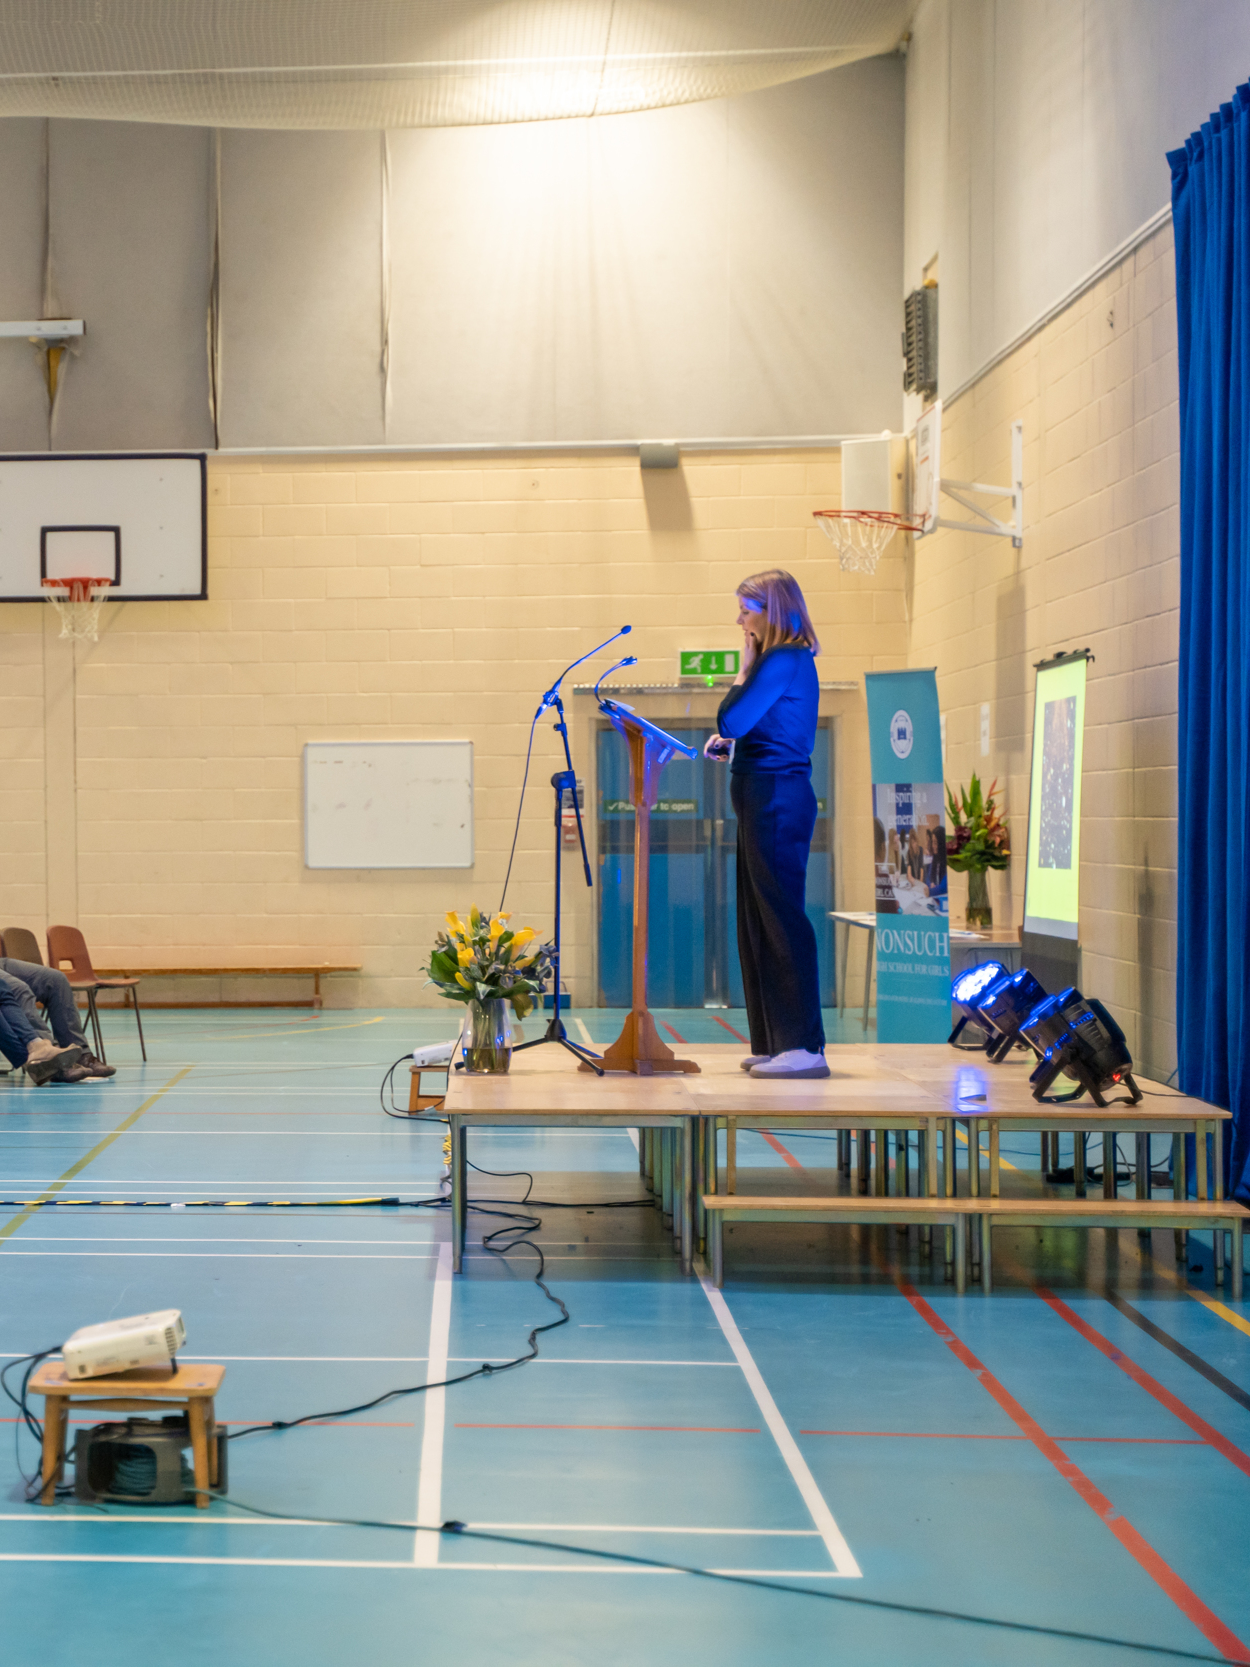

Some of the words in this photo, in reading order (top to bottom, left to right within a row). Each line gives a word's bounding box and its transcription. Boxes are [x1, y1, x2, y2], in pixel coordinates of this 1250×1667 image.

[660, 802, 669, 811] to
[671, 802, 695, 812] open
[888, 961, 914, 974] SCHOOL
[915, 963, 928, 975] FOR
